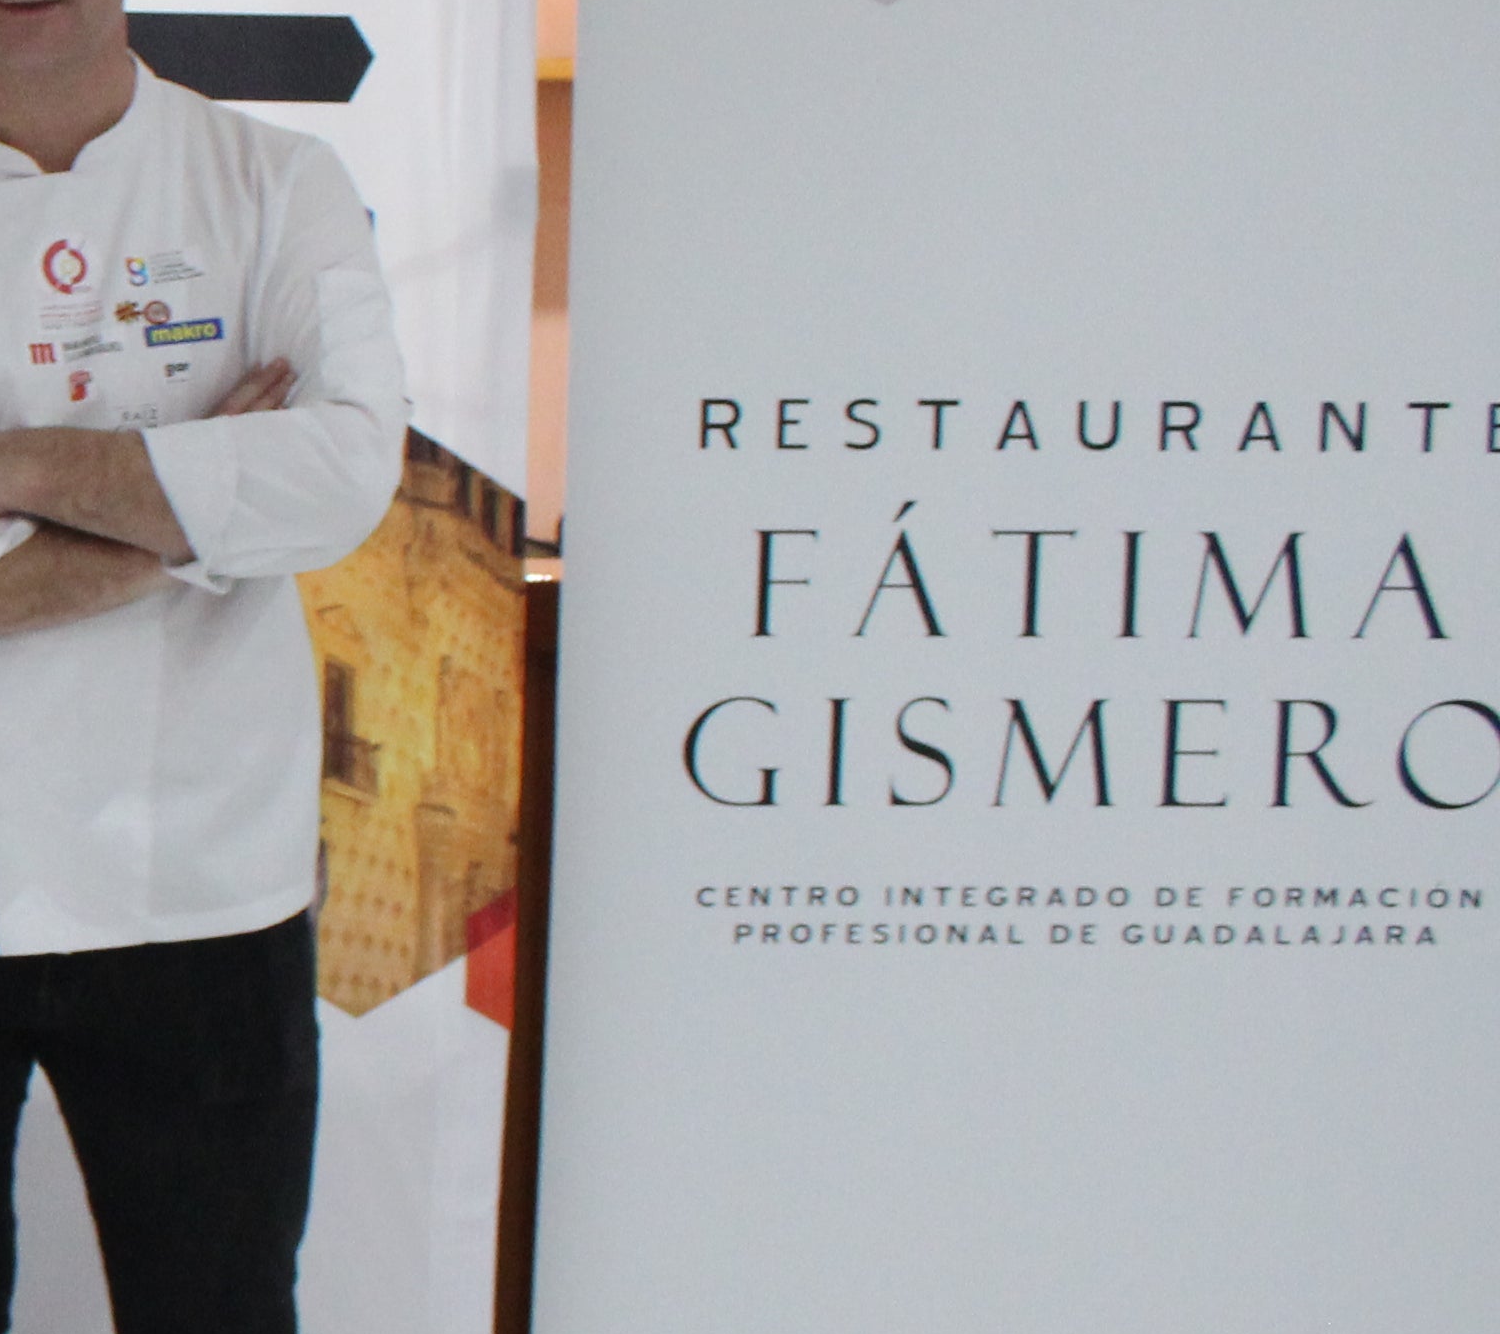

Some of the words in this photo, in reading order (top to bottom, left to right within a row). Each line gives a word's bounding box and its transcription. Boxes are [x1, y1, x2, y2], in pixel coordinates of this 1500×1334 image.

[152, 323, 217, 344] makro
[749, 500, 1452, 641] FÁTIMA
[682, 695, 1500, 809] GISMERO
[696, 885, 862, 909] CENTRO
[885, 885, 1133, 909] INTEGRADO
[1156, 885, 1205, 909] DE
[1228, 881, 1484, 910] FORMACIÓN
[733, 923, 1026, 946] PROFESIONAL
[1049, 923, 1097, 946] DE
[1122, 923, 1439, 947] GUADALAJARA
